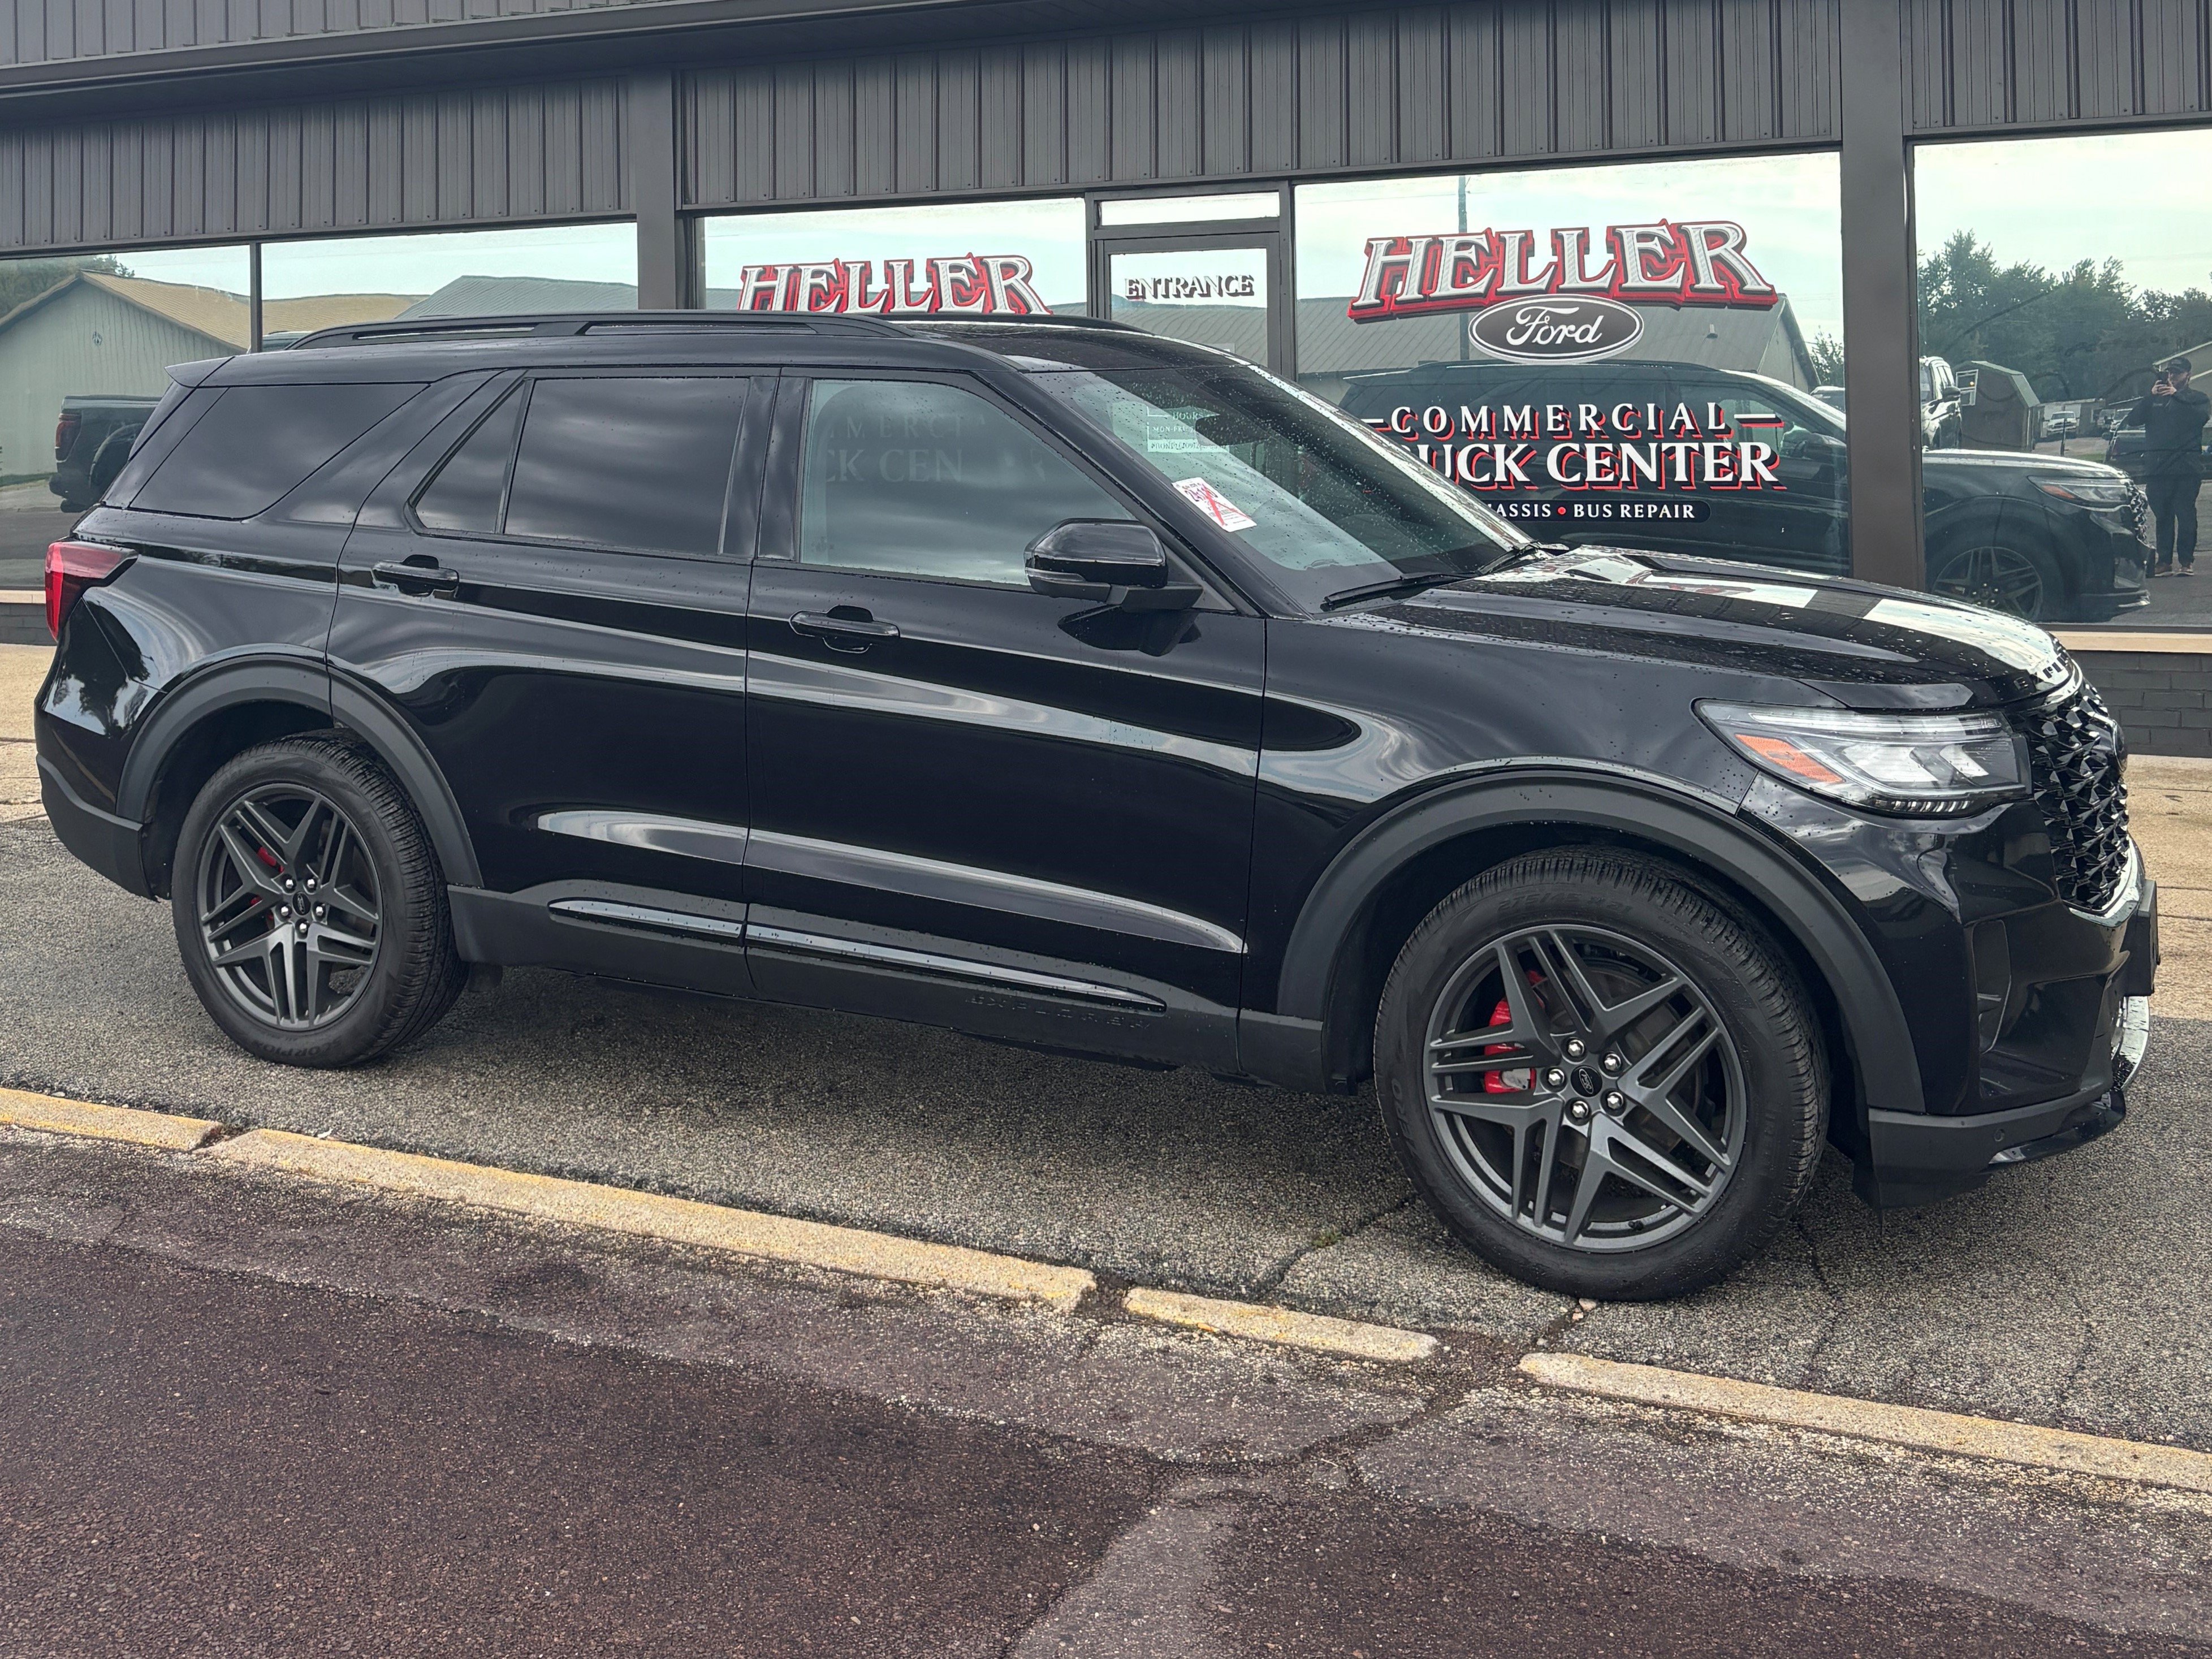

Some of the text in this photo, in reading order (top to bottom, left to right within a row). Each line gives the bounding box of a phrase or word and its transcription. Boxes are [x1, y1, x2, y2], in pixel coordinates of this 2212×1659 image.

[738, 252, 1053, 315] HELLER
[1124, 274, 1255, 300] ENTRANCE
[1347, 219, 1778, 322] HELLER
[1506, 306, 1604, 345] Ford
[1391, 402, 1735, 440] COMMERCIAL
[1546, 442, 1787, 490] CENTER
[1573, 503, 1613, 519] BUS
[1619, 502, 1696, 519] REPAIR
